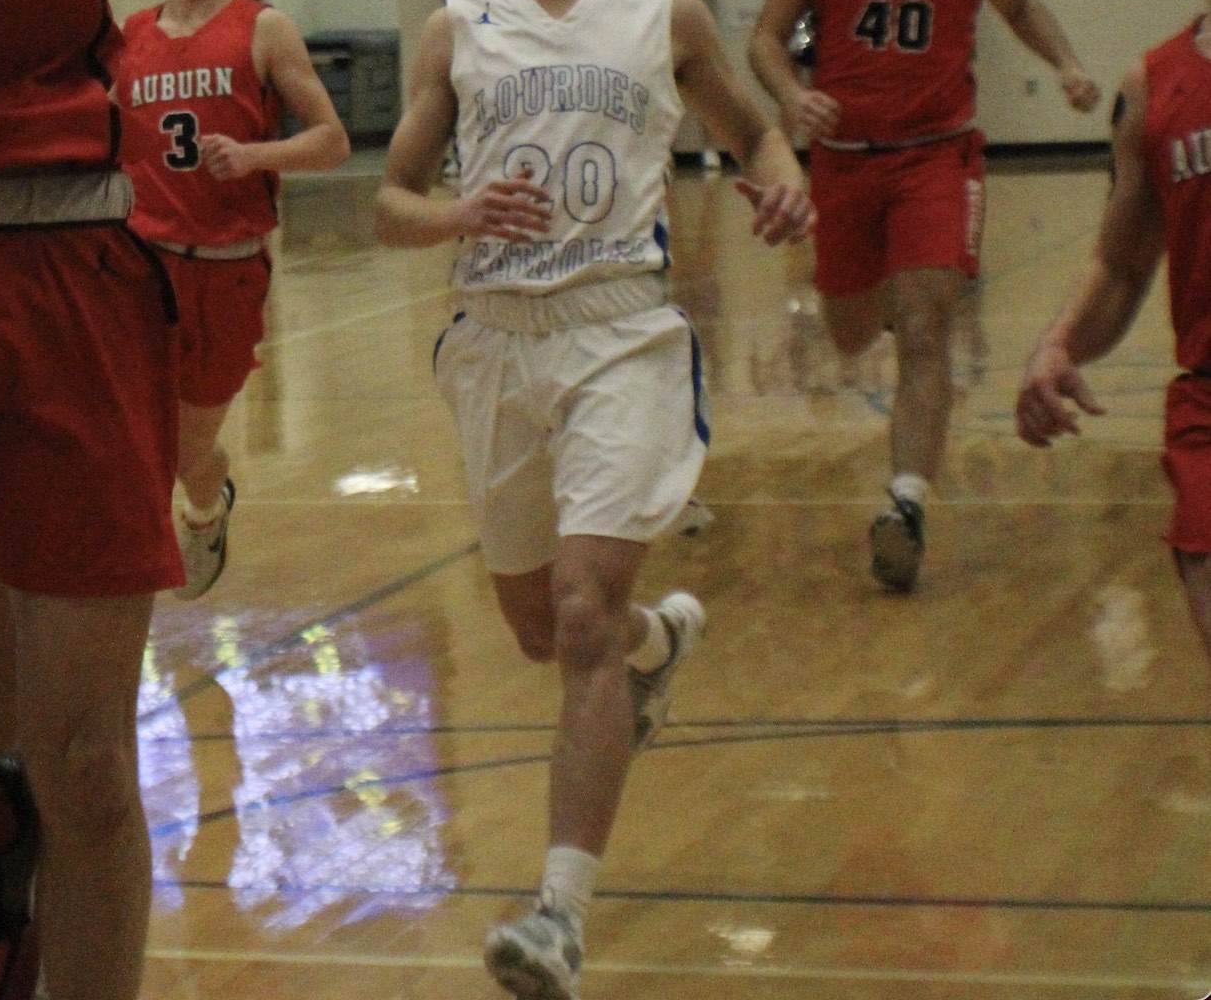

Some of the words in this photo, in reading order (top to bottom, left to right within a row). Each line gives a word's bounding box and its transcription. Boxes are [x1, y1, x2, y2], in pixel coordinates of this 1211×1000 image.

[132, 66, 233, 107] AUBURN
[475, 64, 650, 143] LOURDES
[159, 109, 200, 172] 3
